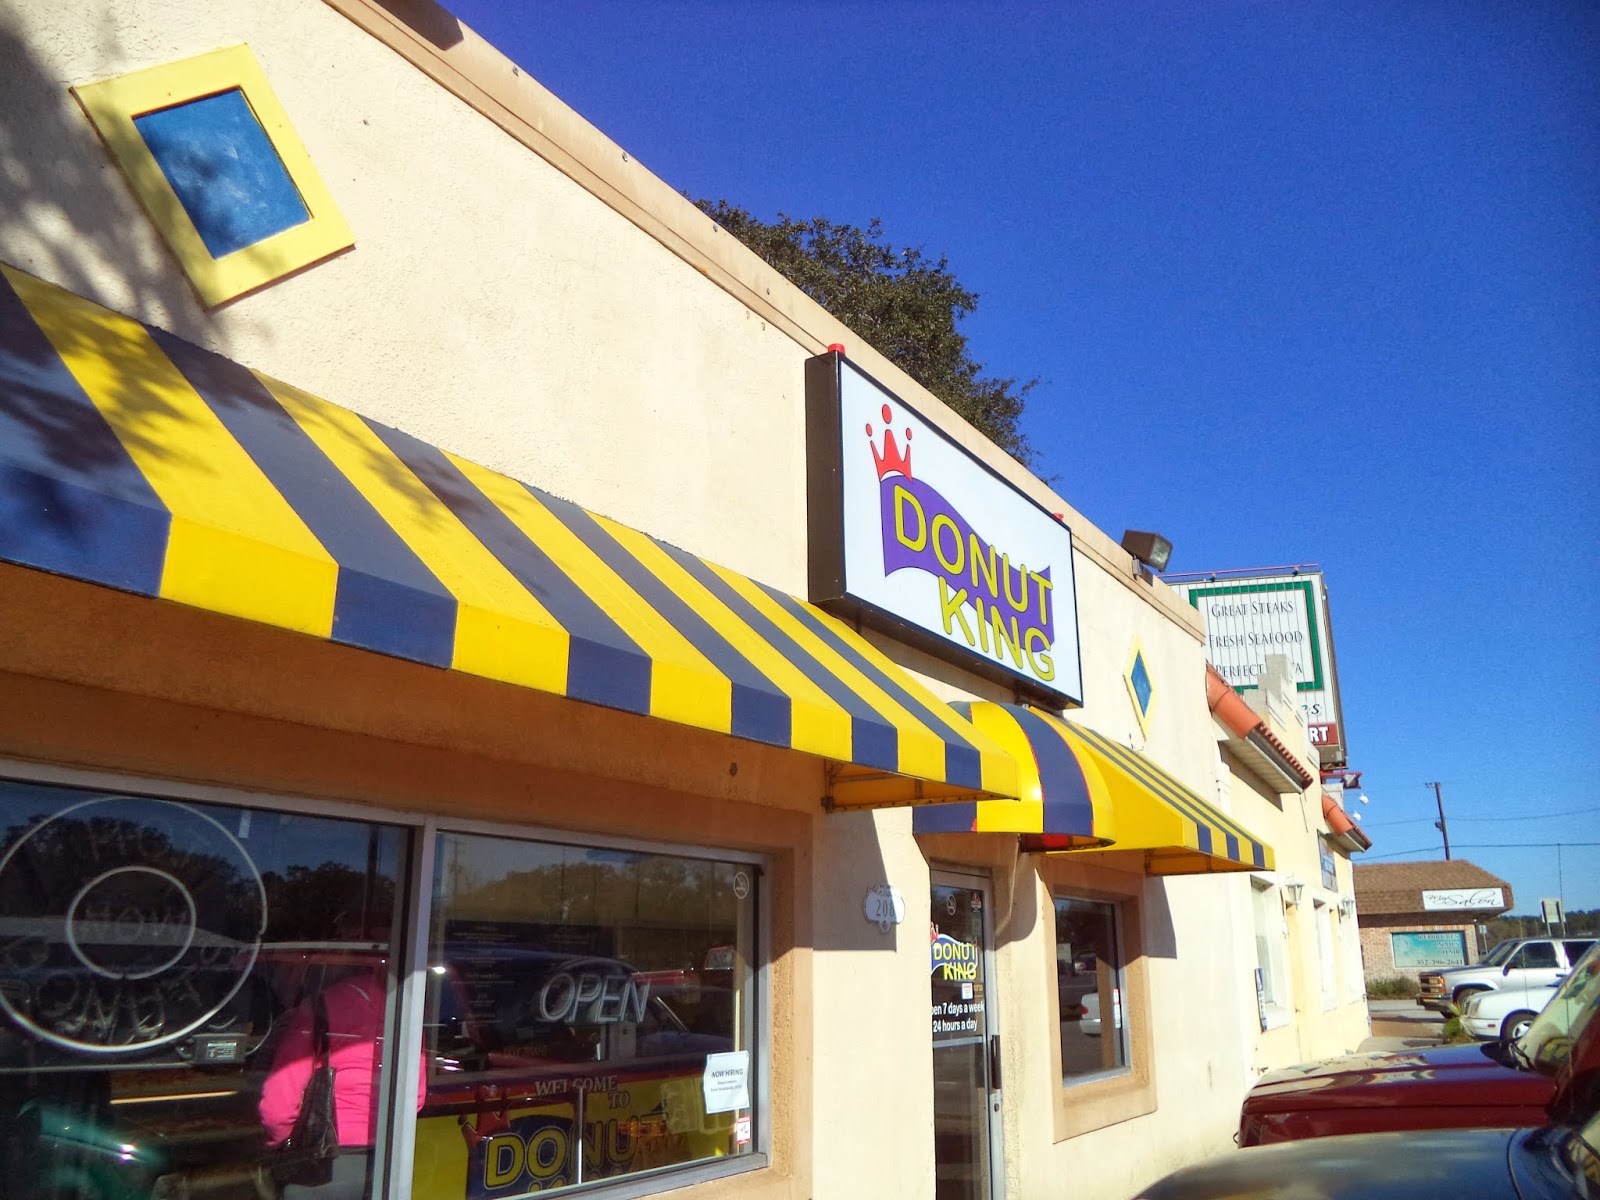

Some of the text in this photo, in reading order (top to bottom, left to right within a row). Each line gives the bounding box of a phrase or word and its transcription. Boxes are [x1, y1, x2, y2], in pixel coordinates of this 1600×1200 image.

[893, 484, 1054, 626] DONUT
[1211, 601, 1294, 618] GREAT STEAKS
[938, 576, 1056, 681] KING
[1209, 631, 1303, 648] FRESH SEAFOOD
[1215, 663, 1265, 678] PERFECT
[933, 942, 976, 960] DONUT
[943, 961, 977, 981] KING
[539, 971, 650, 1025] OPEN
[942, 1002, 948, 1015] 7
[948, 1002, 963, 1017] days
[963, 1004, 969, 1014] a
[968, 1001, 985, 1013] week
[932, 1018, 978, 1033] 24 hours a day
[711, 1068, 744, 1078] NOW HIRING
[534, 1074, 619, 1097] WELCOME
[608, 1090, 631, 1110] TO
[483, 1111, 671, 1190] DONUT
